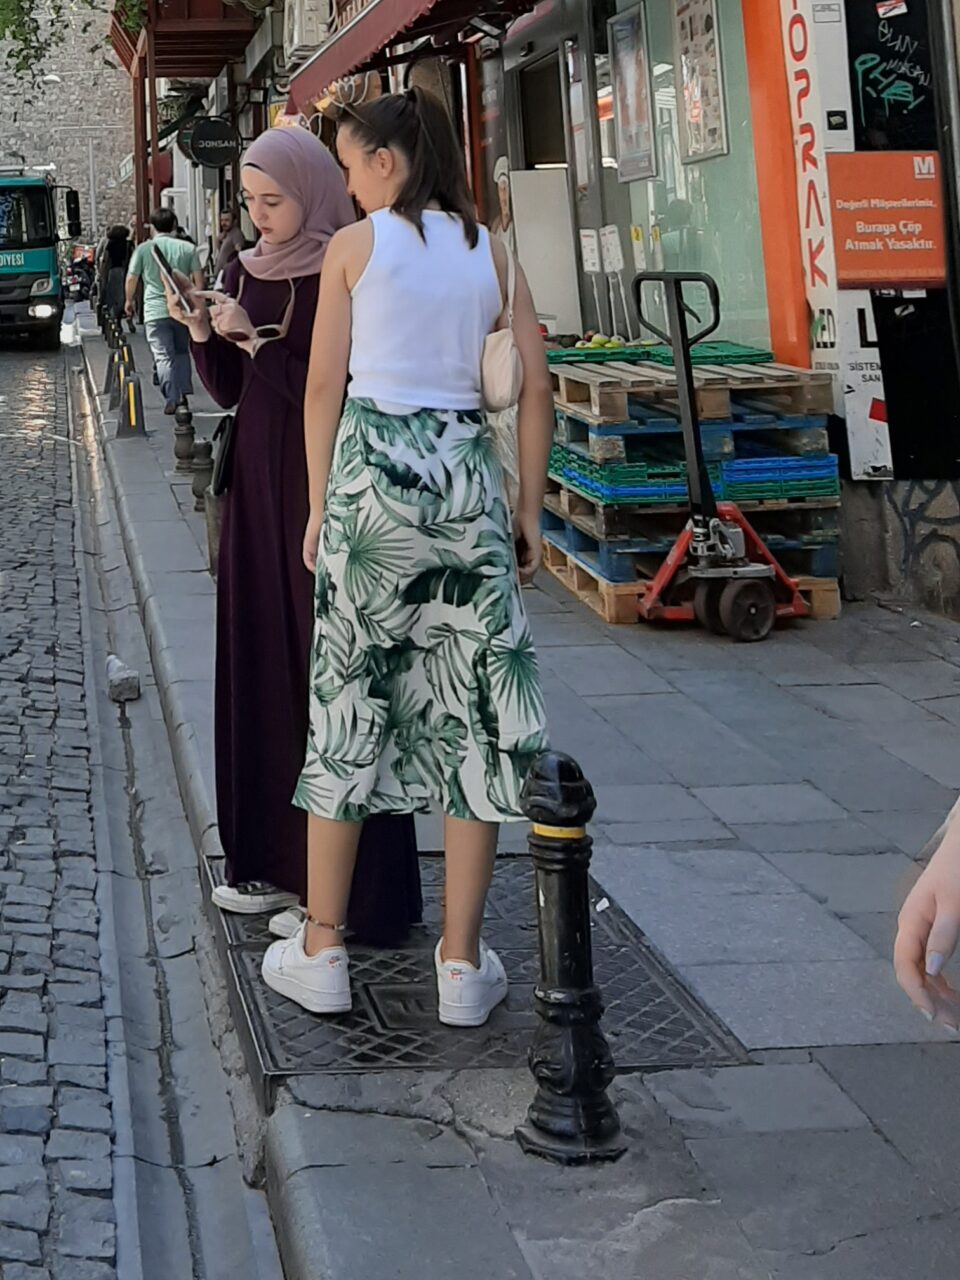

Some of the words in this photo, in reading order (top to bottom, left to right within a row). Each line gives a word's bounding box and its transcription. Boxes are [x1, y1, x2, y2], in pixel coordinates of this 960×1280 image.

[912, 155, 936, 175] M
[855, 221, 897, 235] Buraya
[898, 219, 923, 235] Çöp
[844, 237, 884, 250] Atmak
